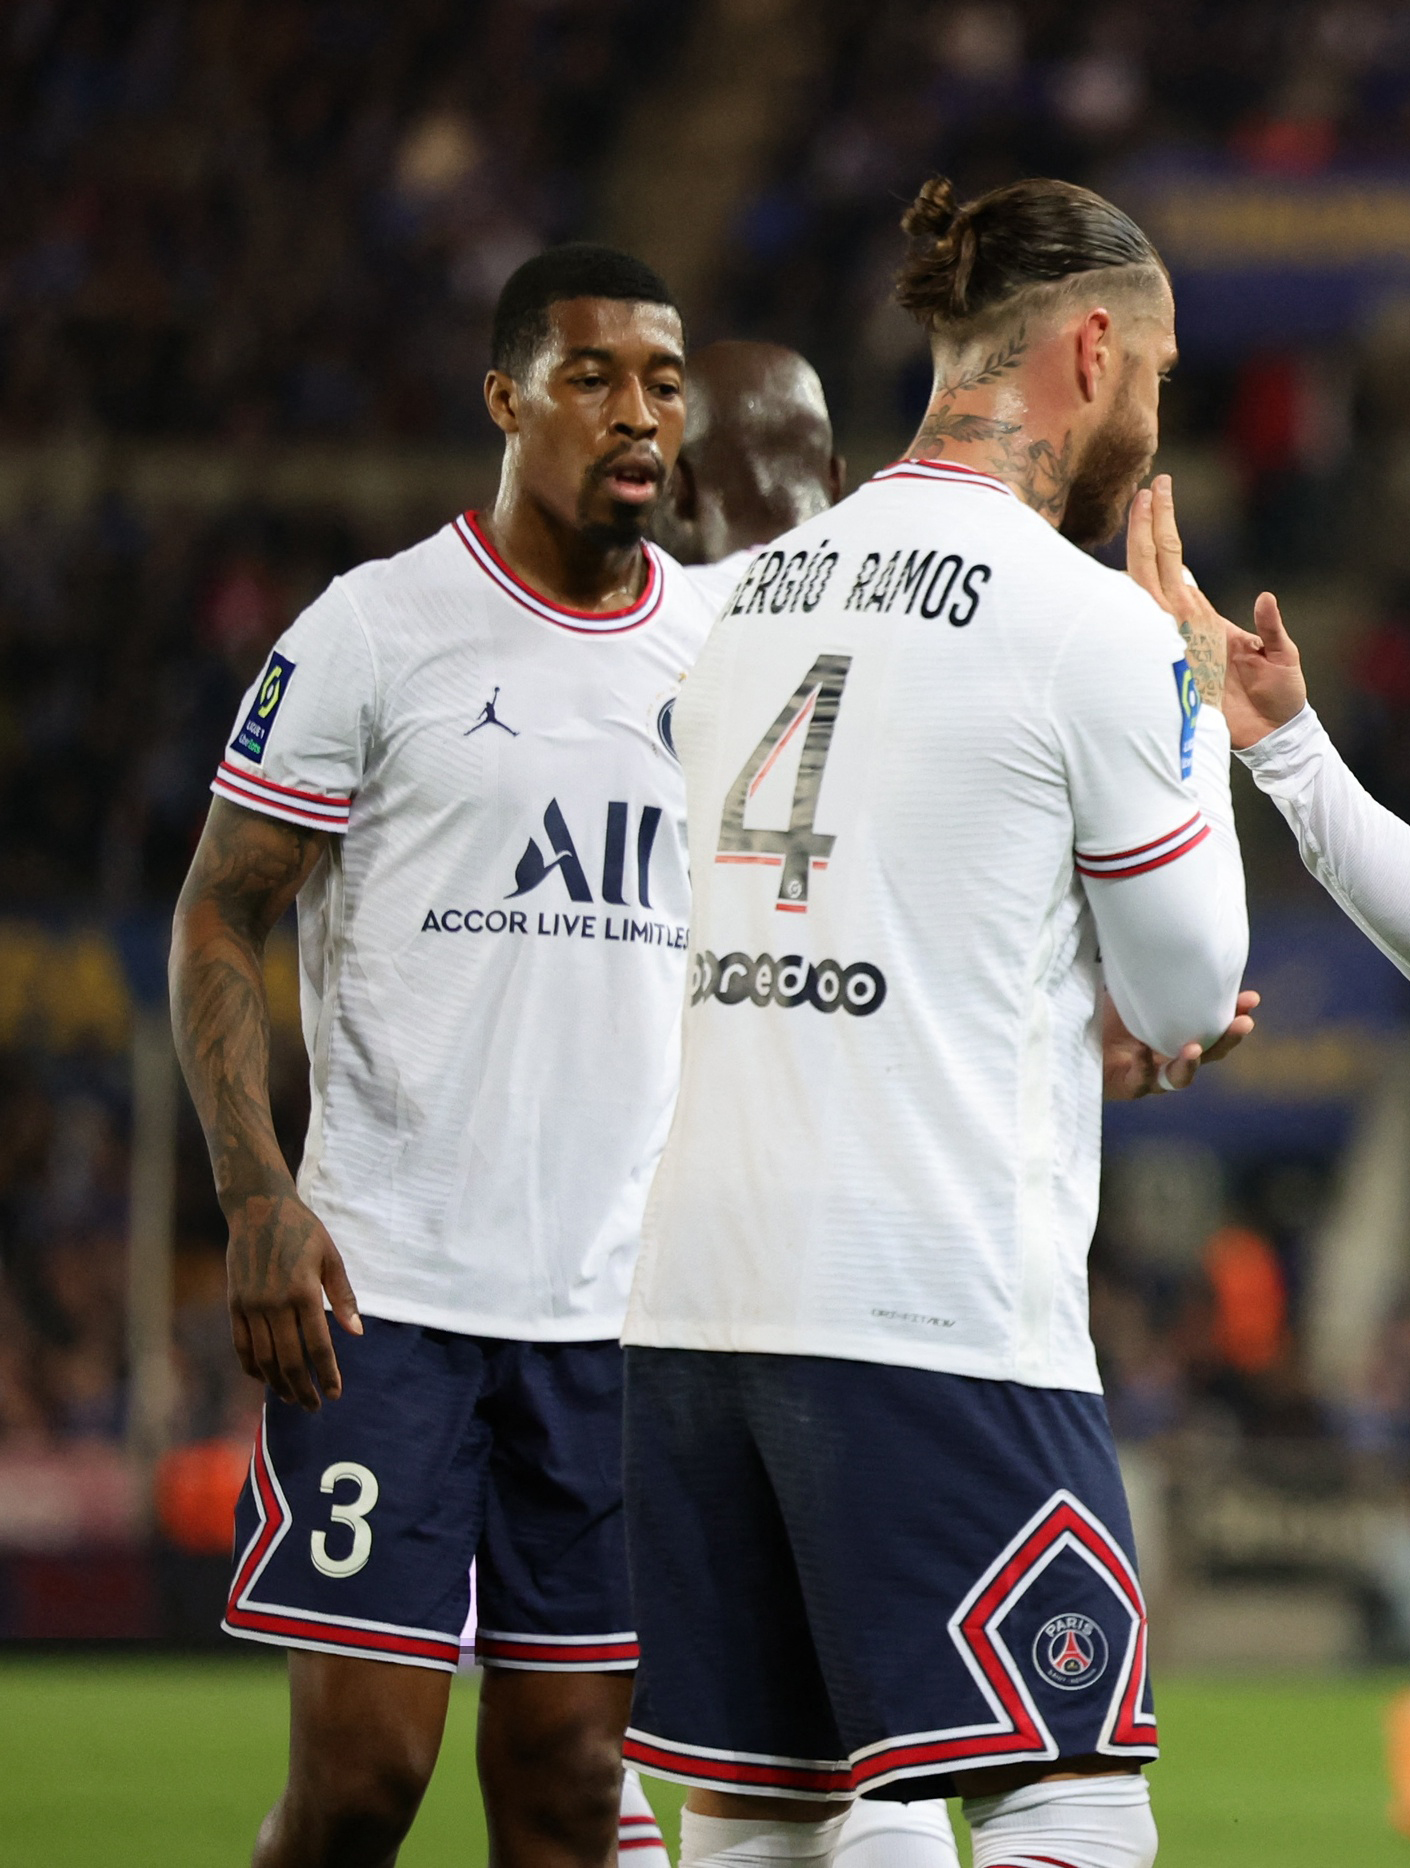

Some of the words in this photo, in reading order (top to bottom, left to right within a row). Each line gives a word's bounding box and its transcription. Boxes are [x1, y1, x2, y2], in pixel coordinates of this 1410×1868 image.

[721, 539, 839, 622] ERGÍO
[844, 549, 992, 627] RAMOS
[715, 653, 853, 912] 4
[421, 909, 528, 933] ACCOR
[538, 913, 596, 939] LIVE
[604, 917, 690, 950] LIMITLES
[310, 1461, 380, 1578] 3
[1045, 1617, 1095, 1637] PARIS
